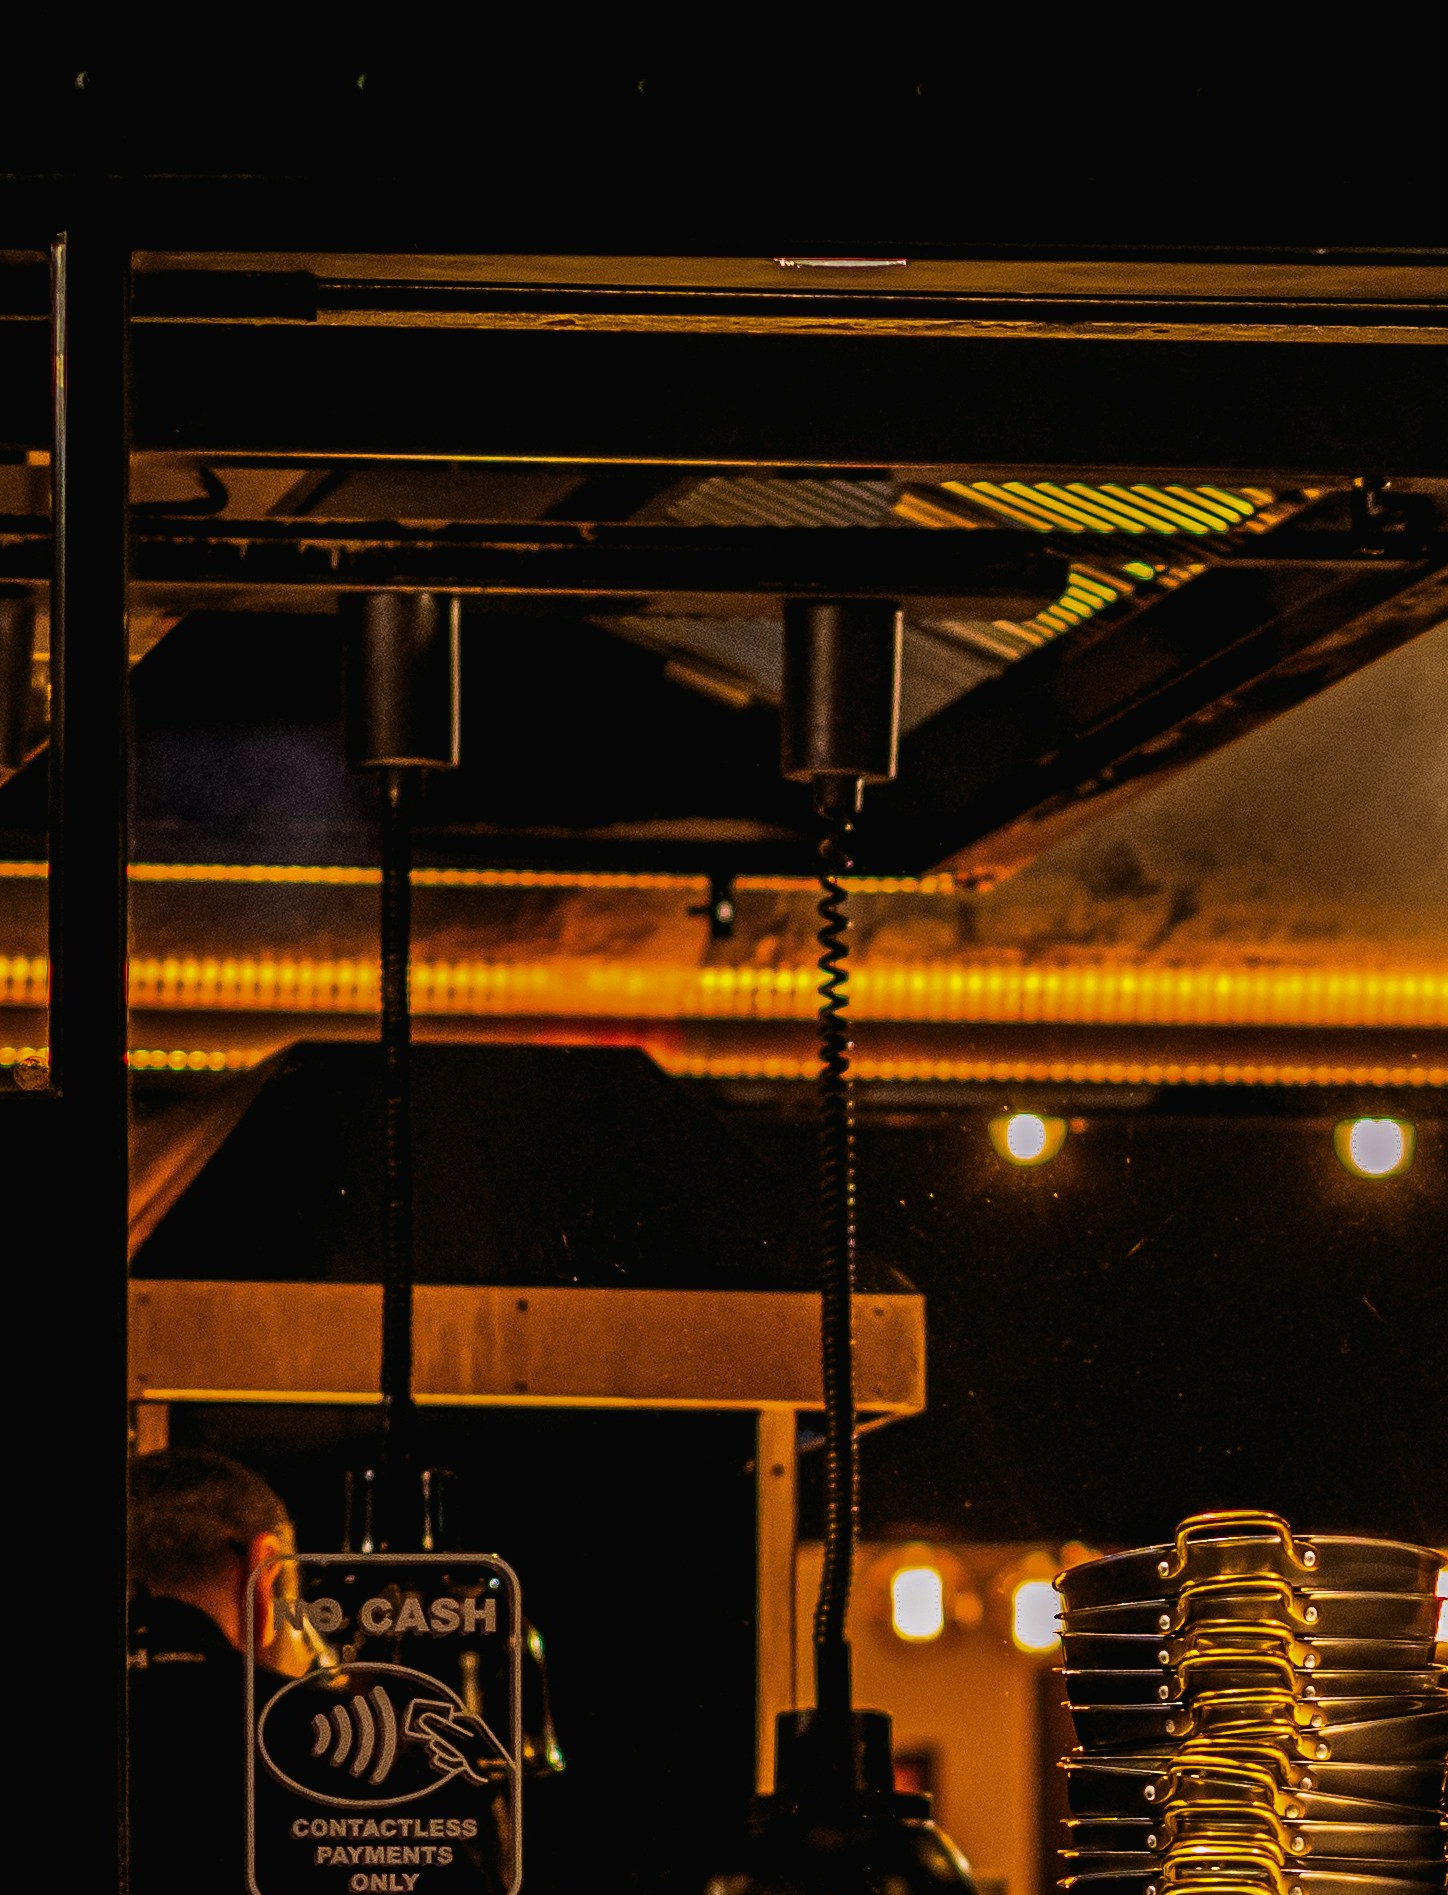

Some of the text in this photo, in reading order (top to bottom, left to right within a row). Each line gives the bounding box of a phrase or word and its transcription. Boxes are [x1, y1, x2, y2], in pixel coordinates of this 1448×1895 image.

[272, 1597, 499, 1635] NO CASH
[290, 1817, 479, 1839] CONTACTLESS
[314, 1845, 455, 1867] PAYMENTS
[349, 1872, 420, 1894] ONLY
